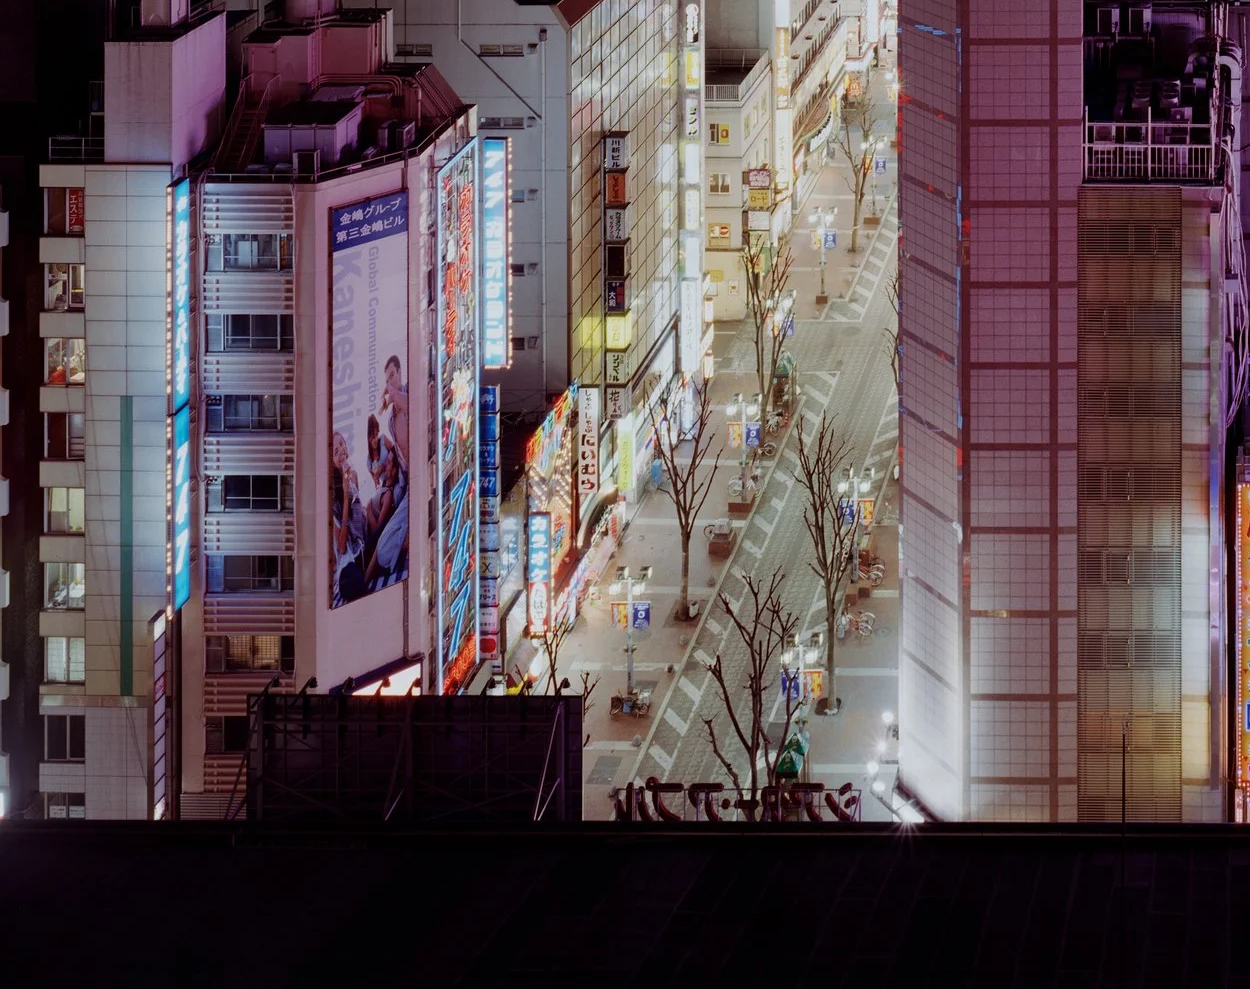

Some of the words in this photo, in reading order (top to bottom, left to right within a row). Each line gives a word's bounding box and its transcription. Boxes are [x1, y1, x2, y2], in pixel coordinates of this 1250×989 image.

[69, 195, 78, 224] エステ
[335, 215, 405, 243] 第三金嶋ビル
[339, 198, 402, 226] 金嶋グループ
[368, 245, 380, 293] Global
[367, 296, 380, 413] Communication
[580, 433, 596, 490] にいむら
[448, 468, 472, 662] 747
